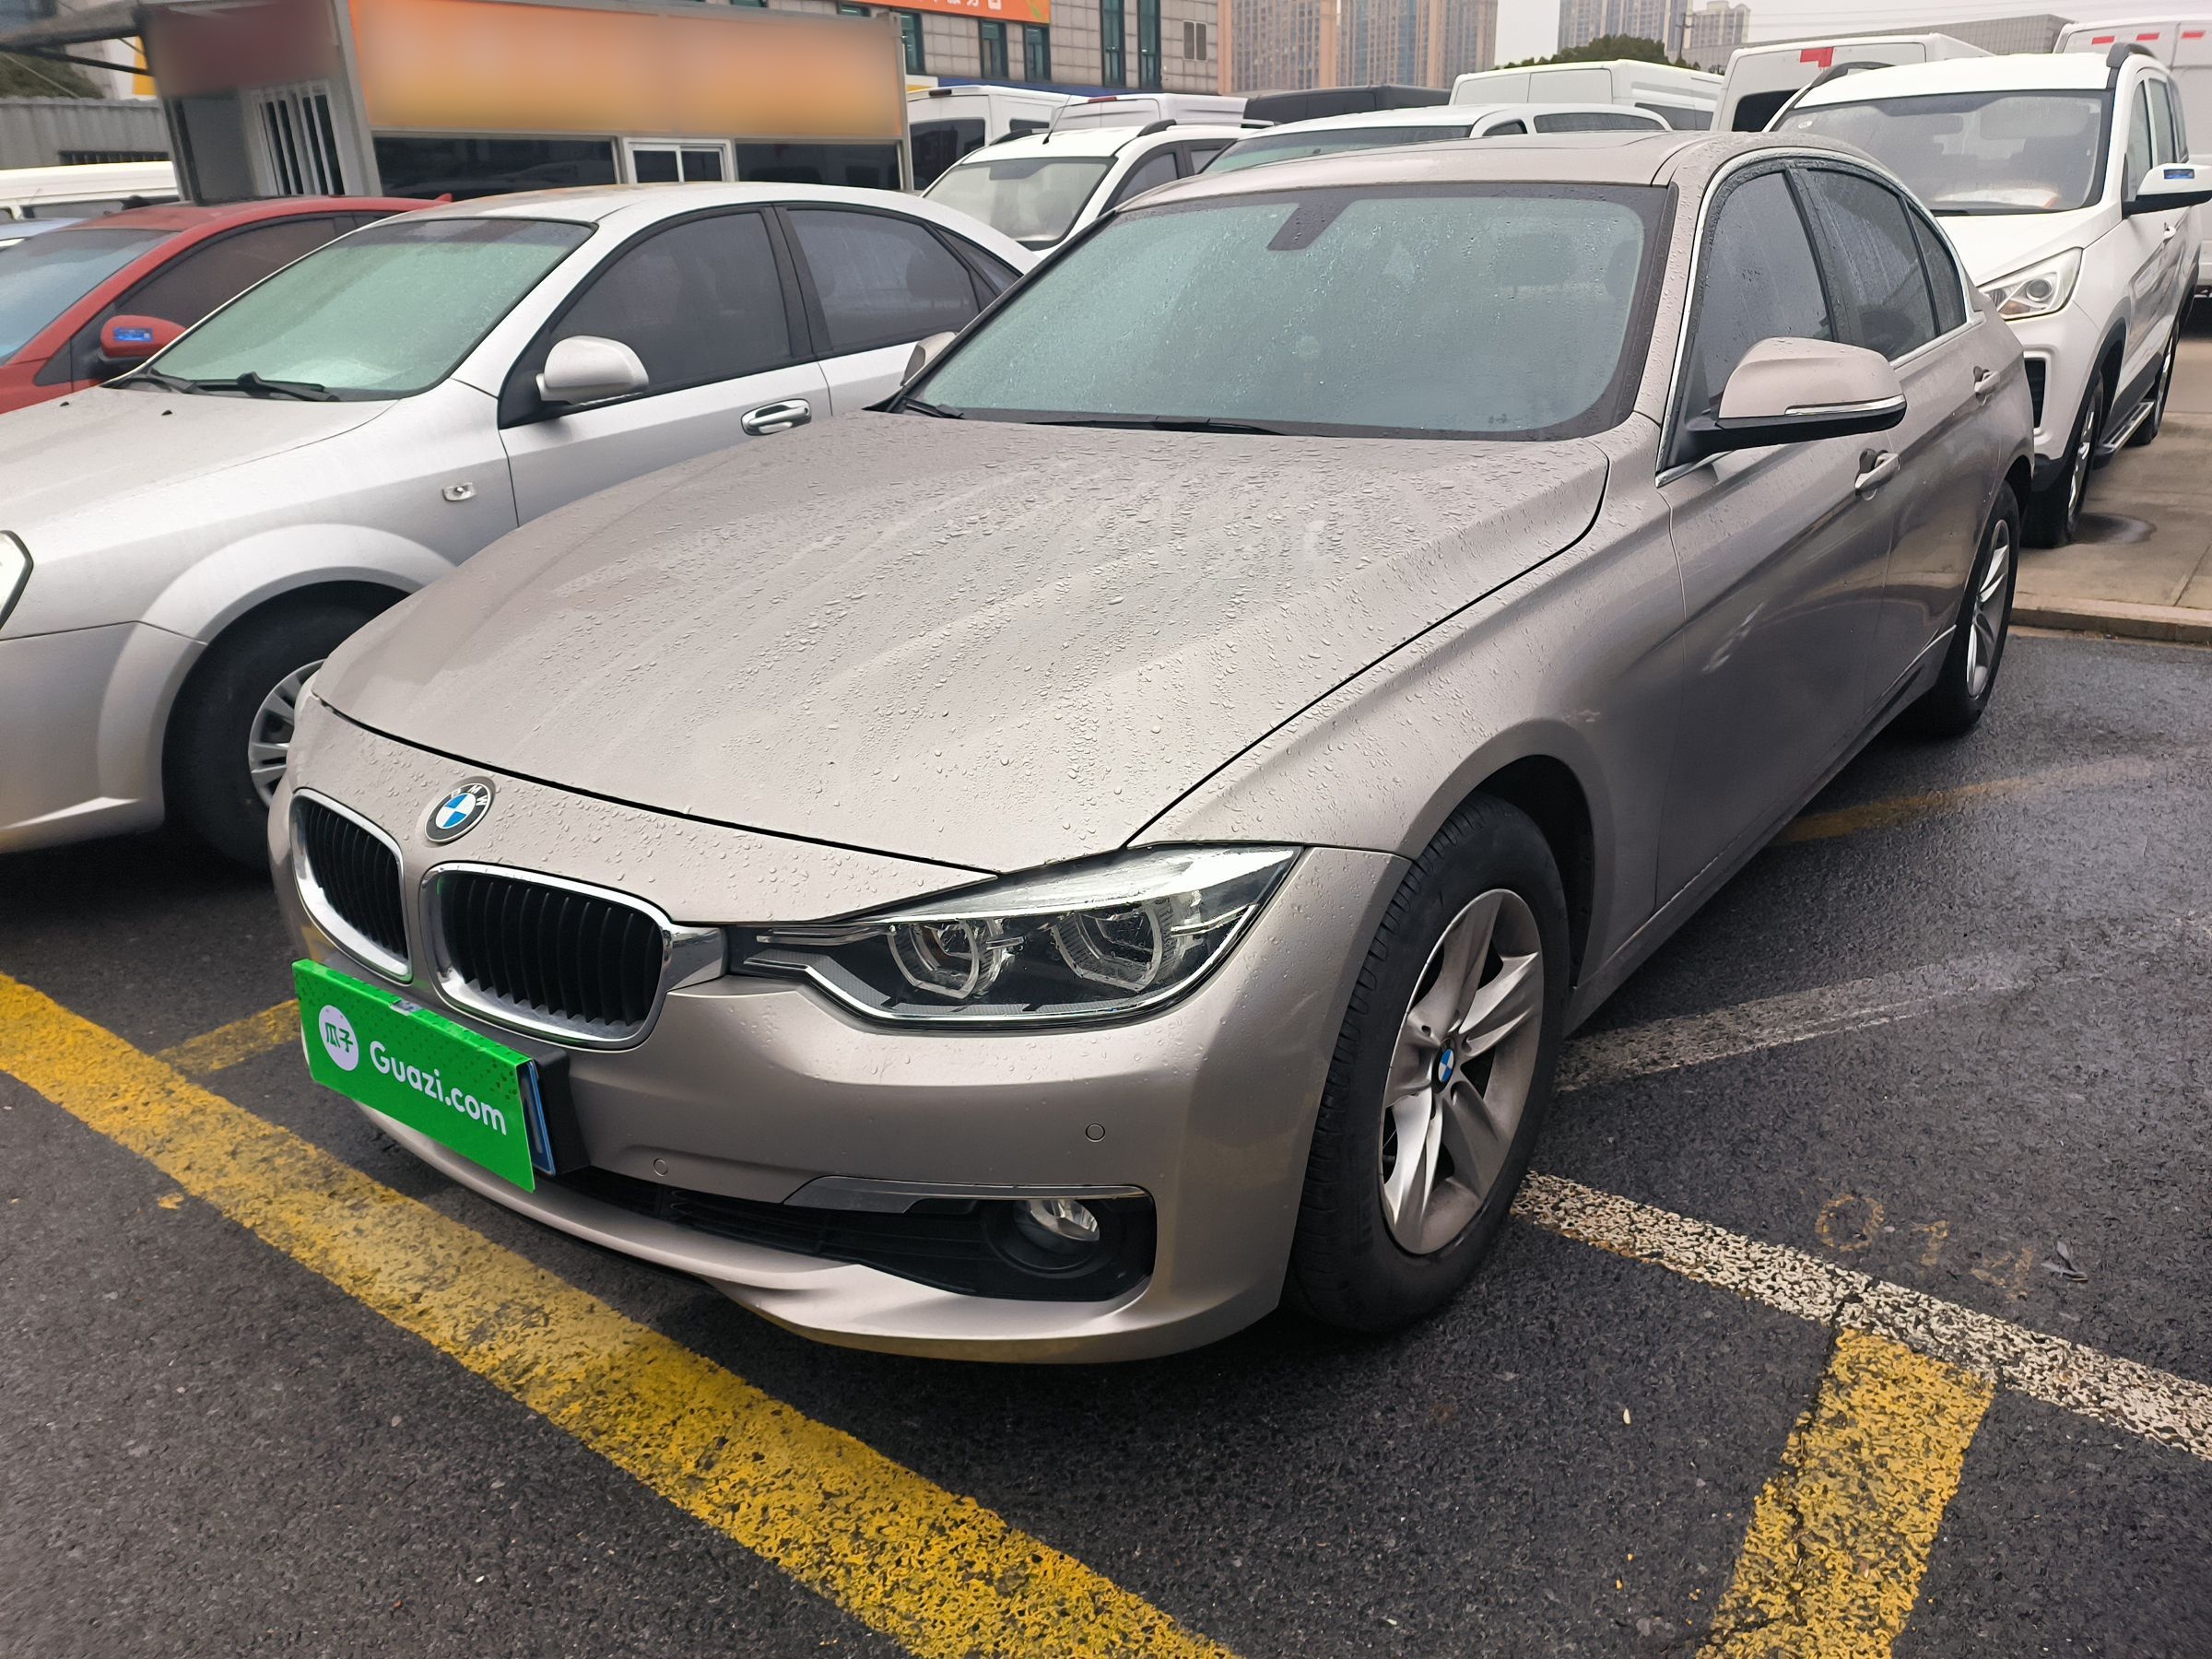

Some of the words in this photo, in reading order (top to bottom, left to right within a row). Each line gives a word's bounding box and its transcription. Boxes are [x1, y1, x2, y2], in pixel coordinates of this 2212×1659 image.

[450, 784, 488, 806] BMW
[324, 1021, 354, 1053] 瓜子
[369, 1040, 508, 1135] Guazi.com
